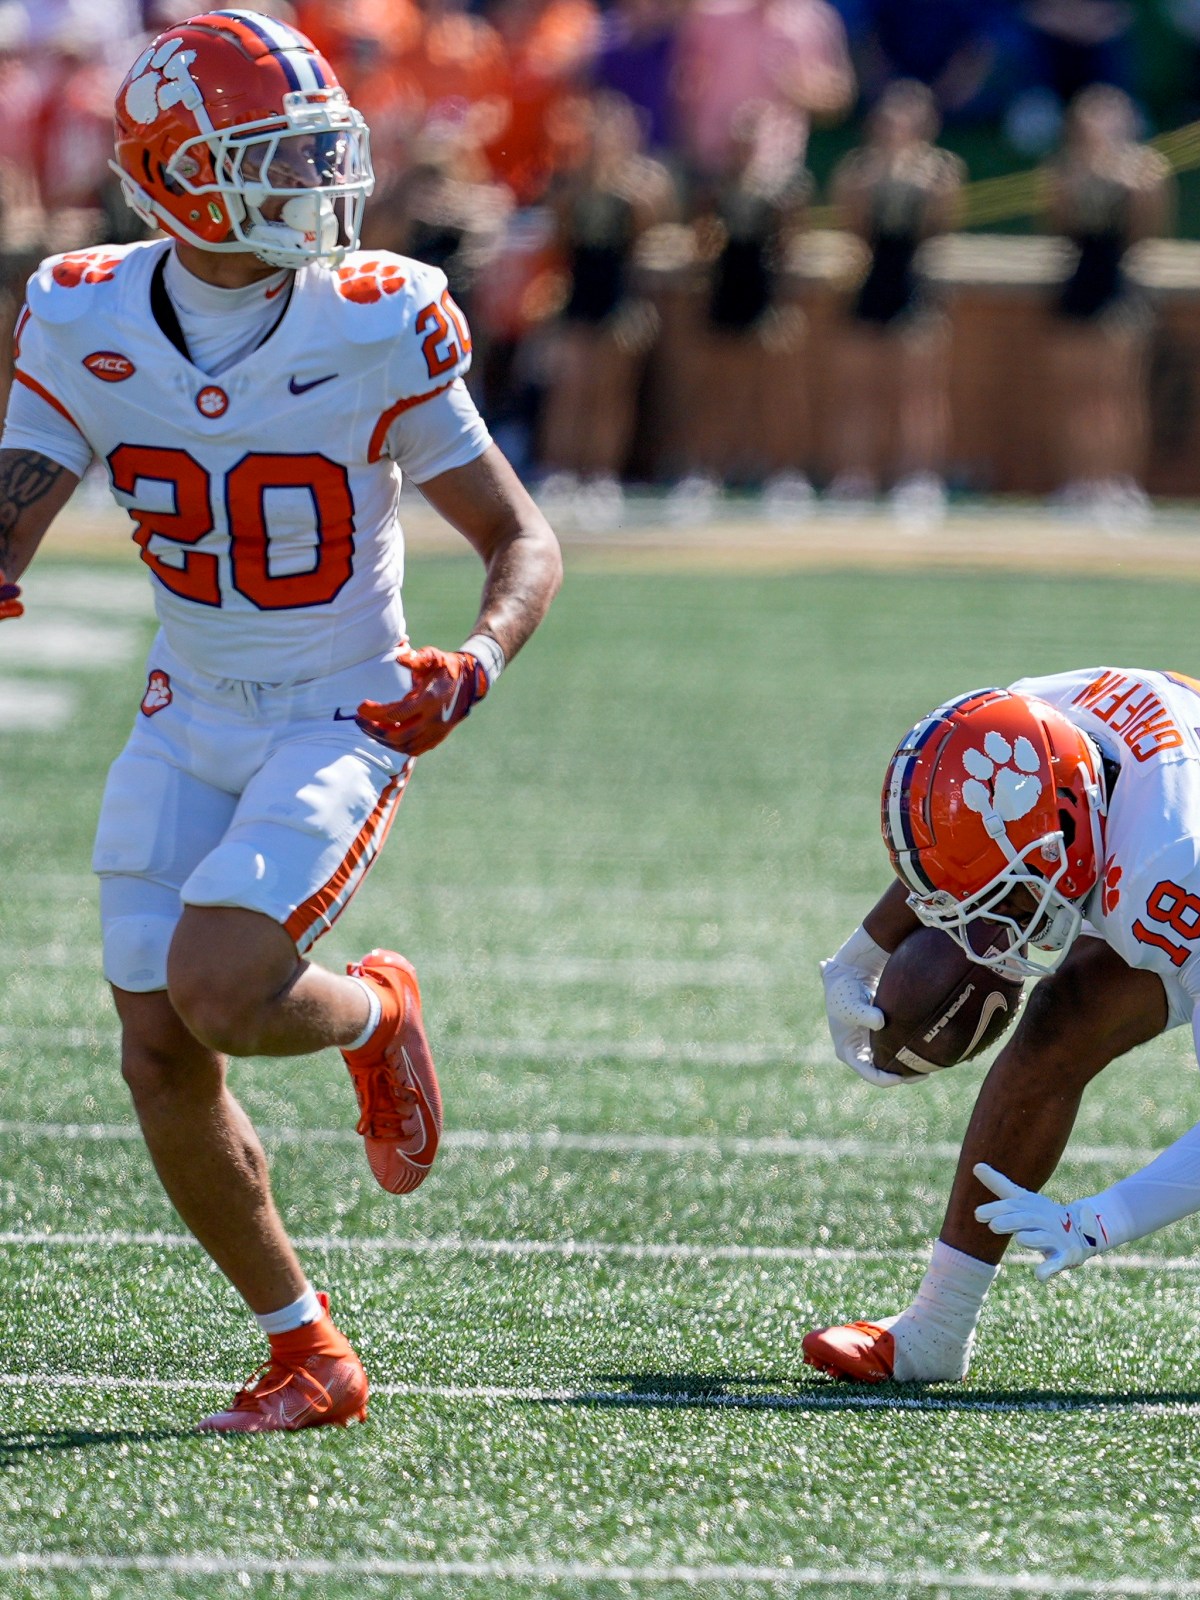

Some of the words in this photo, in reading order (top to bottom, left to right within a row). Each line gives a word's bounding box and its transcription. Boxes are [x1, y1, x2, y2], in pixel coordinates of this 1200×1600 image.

[89, 358, 130, 373] ACC
[415, 289, 472, 380] 20
[106, 442, 356, 611] 20
[1071, 670, 1184, 763] GRIFFIN
